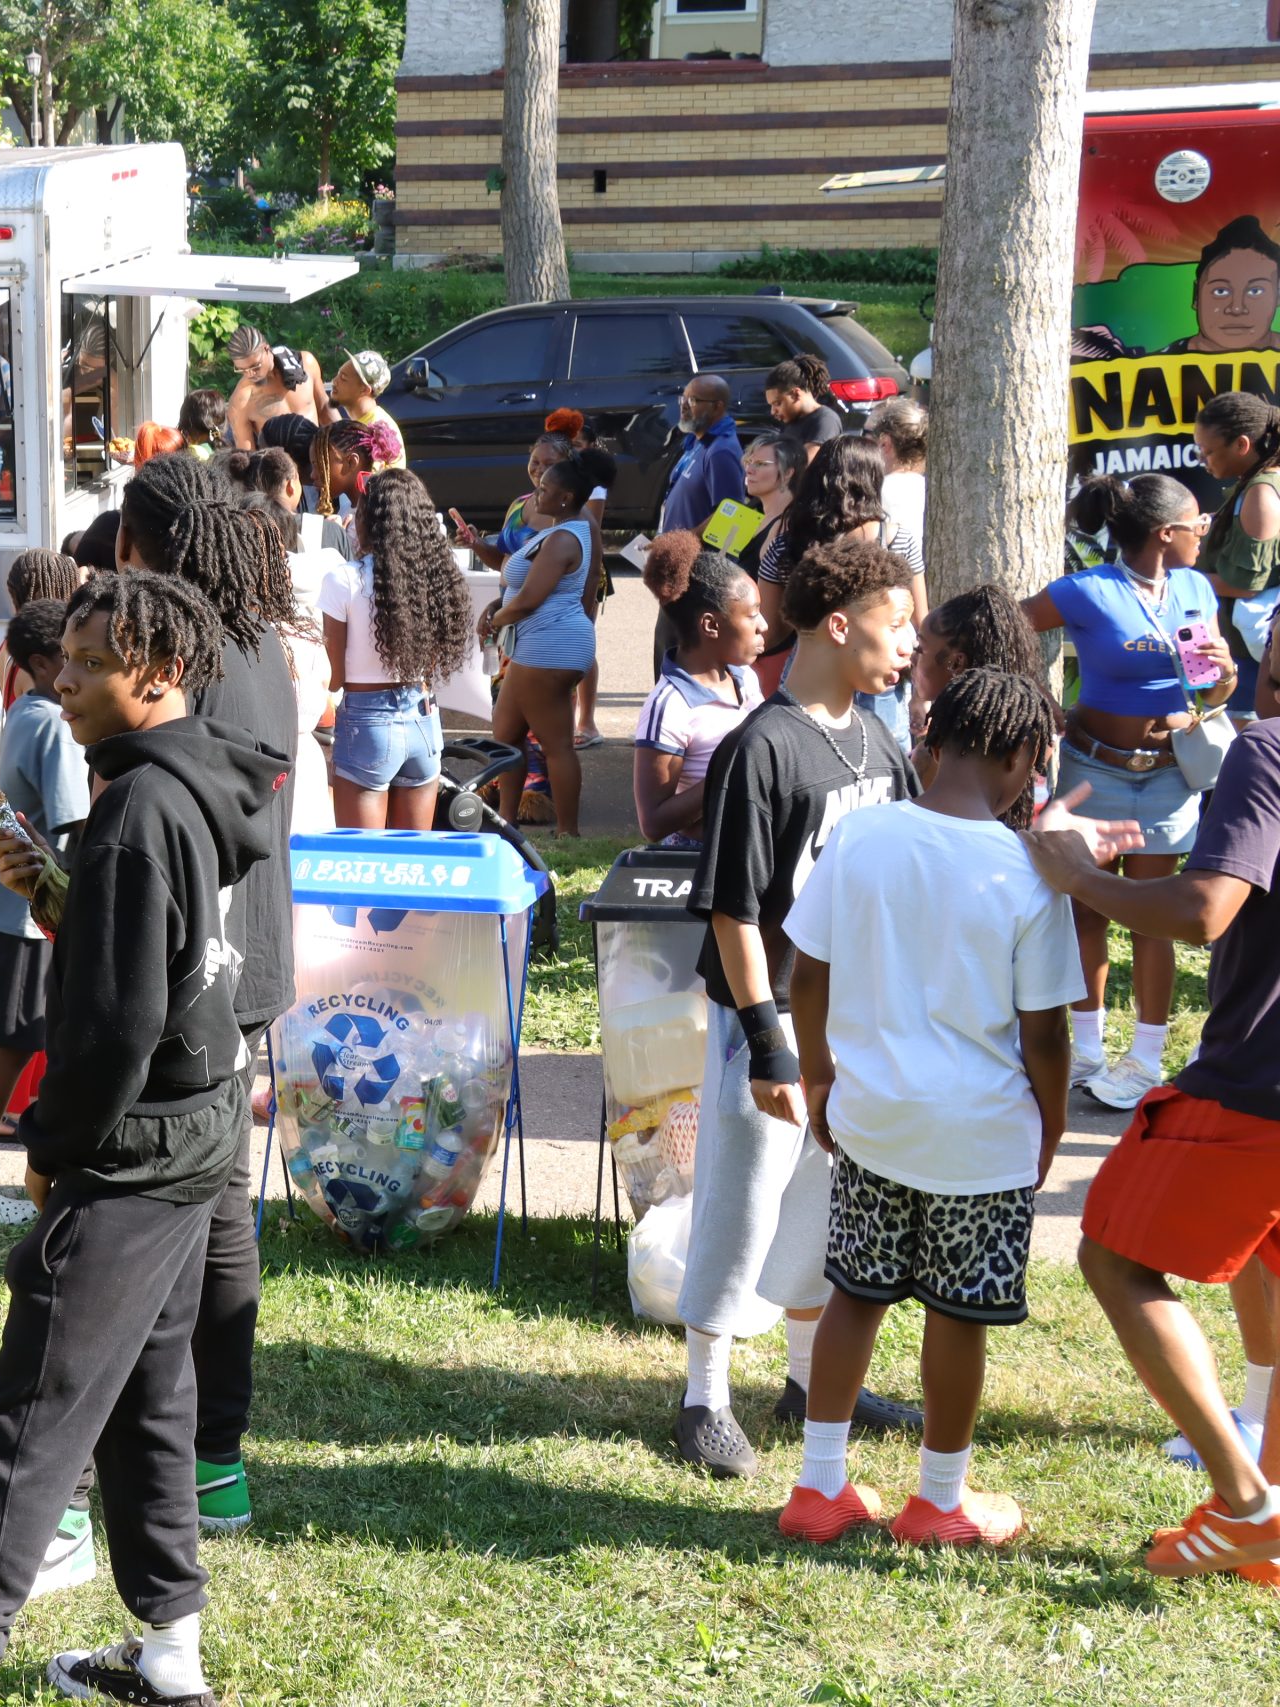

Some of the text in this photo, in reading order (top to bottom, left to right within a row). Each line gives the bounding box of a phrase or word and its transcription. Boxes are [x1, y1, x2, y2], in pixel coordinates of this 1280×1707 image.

[1093, 444, 1206, 475] JAMAIC
[1123, 640, 1167, 653] CELE
[317, 859, 424, 876] BOTTLES
[312, 870, 448, 887] CANS ONLY
[633, 878, 693, 898] TRA
[308, 993, 410, 1031] RECYCLING
[313, 1161, 401, 1193] RECYCLING
